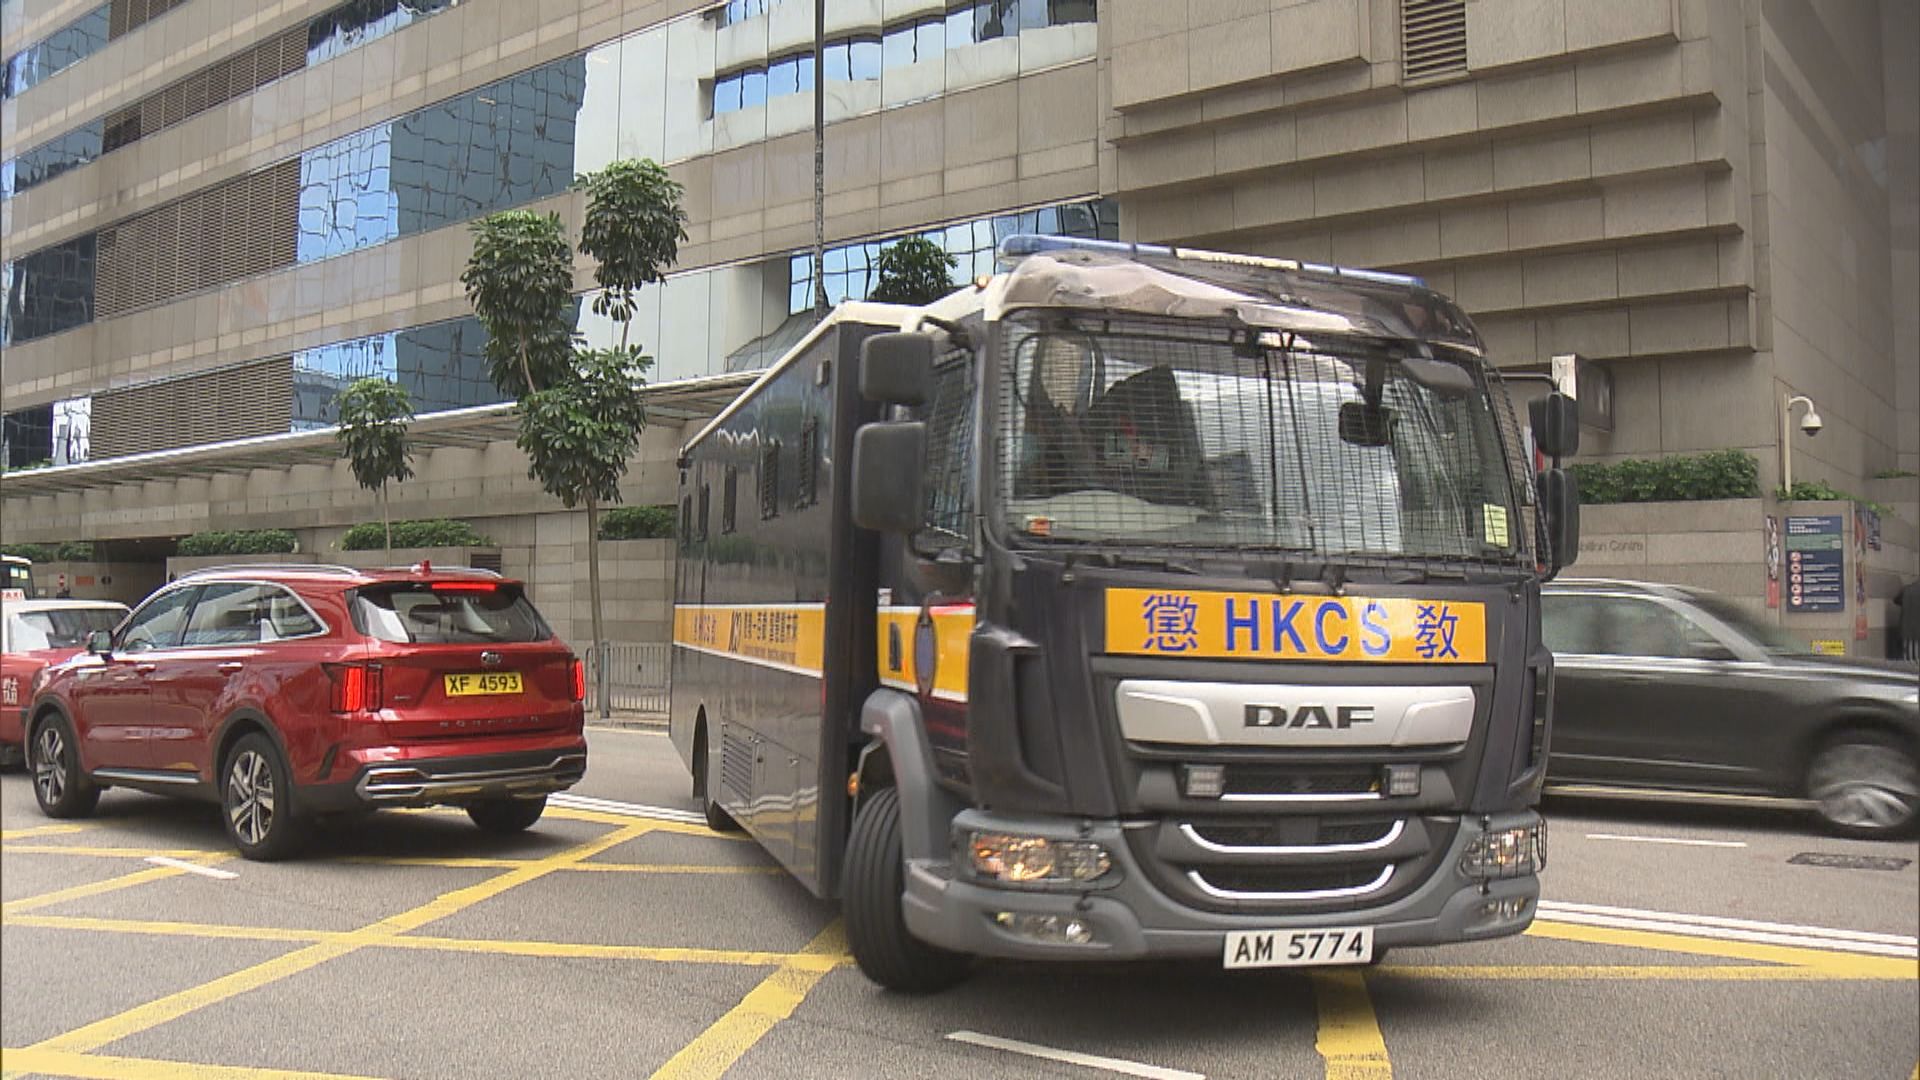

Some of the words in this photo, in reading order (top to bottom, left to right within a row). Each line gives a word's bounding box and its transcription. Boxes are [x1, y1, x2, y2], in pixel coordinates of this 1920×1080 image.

[1143, 594, 1198, 651] 懲
[1225, 597, 1391, 656] HKCS
[449, 676, 470, 693] XF
[478, 675, 519, 691] 4593
[1244, 704, 1375, 729] DAF
[1234, 935, 1274, 962] AM
[1287, 931, 1364, 959] 5774
